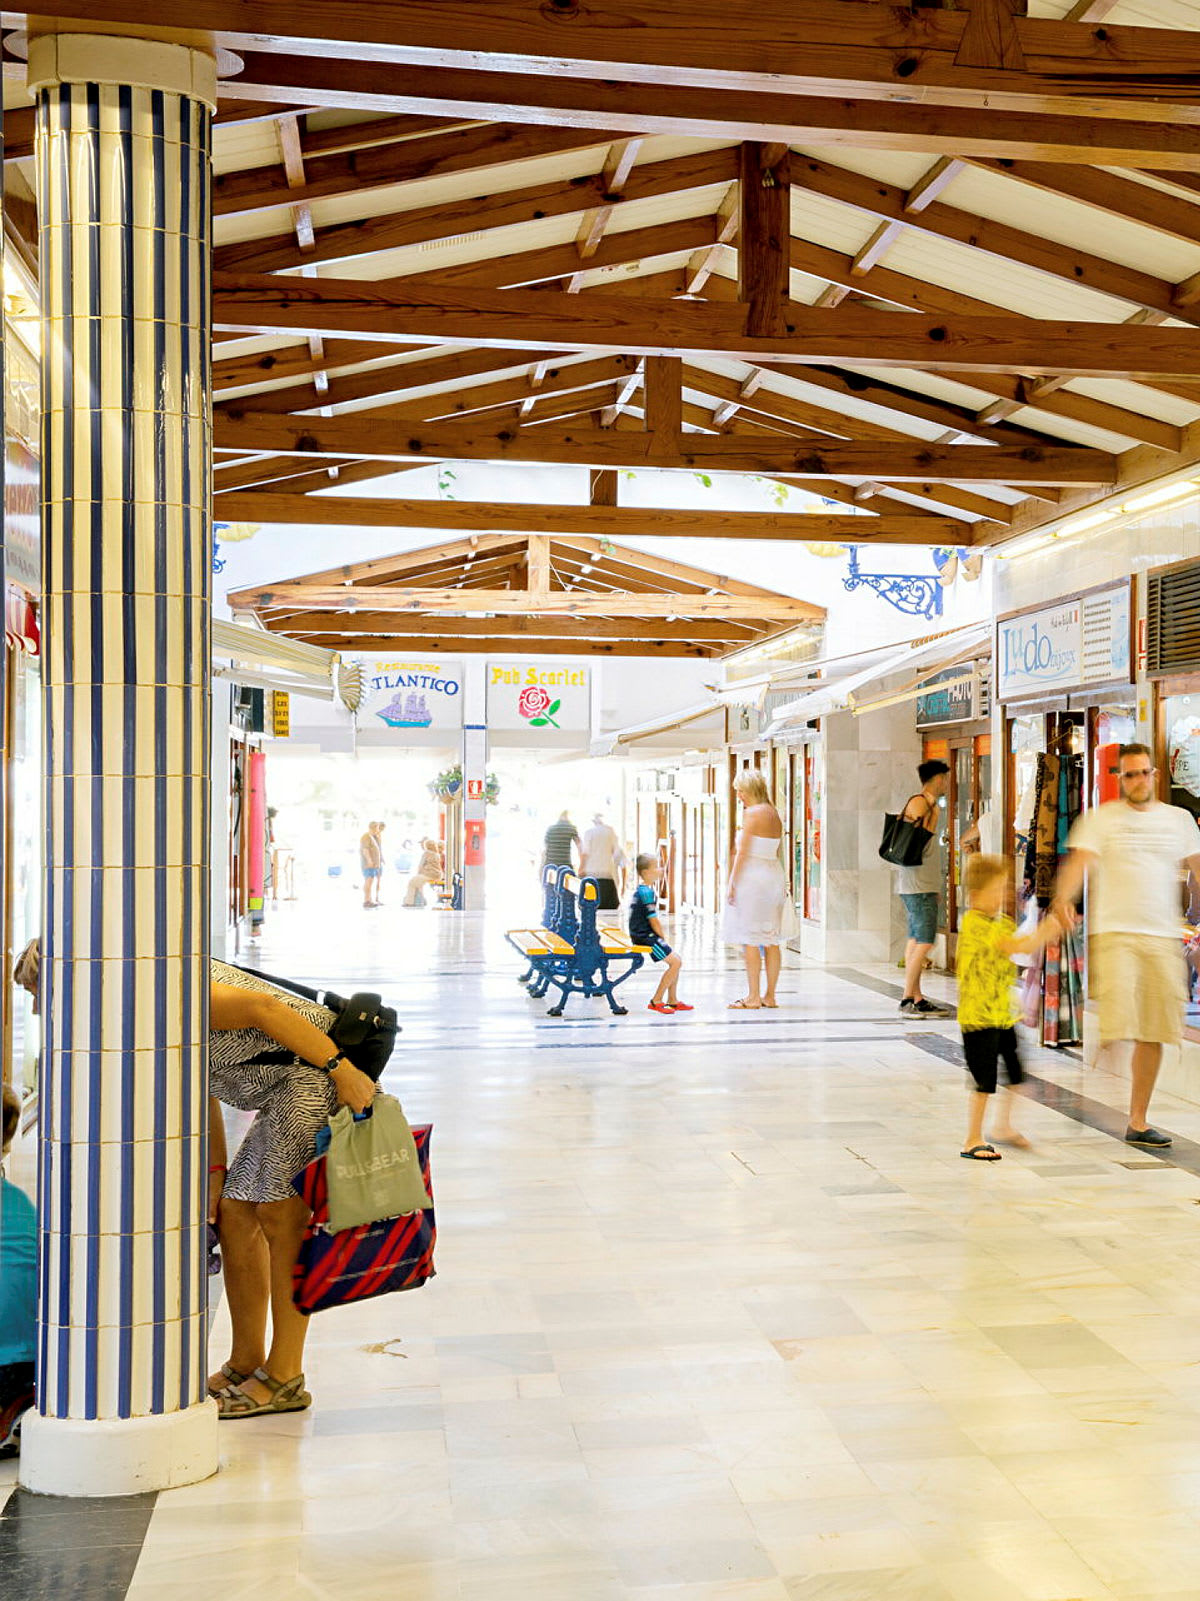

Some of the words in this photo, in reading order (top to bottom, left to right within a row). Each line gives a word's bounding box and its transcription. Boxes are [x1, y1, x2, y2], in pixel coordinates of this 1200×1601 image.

[369, 674, 459, 696] TLANTICO
[491, 666, 520, 685] Pub
[524, 667, 586, 686] Scarlet
